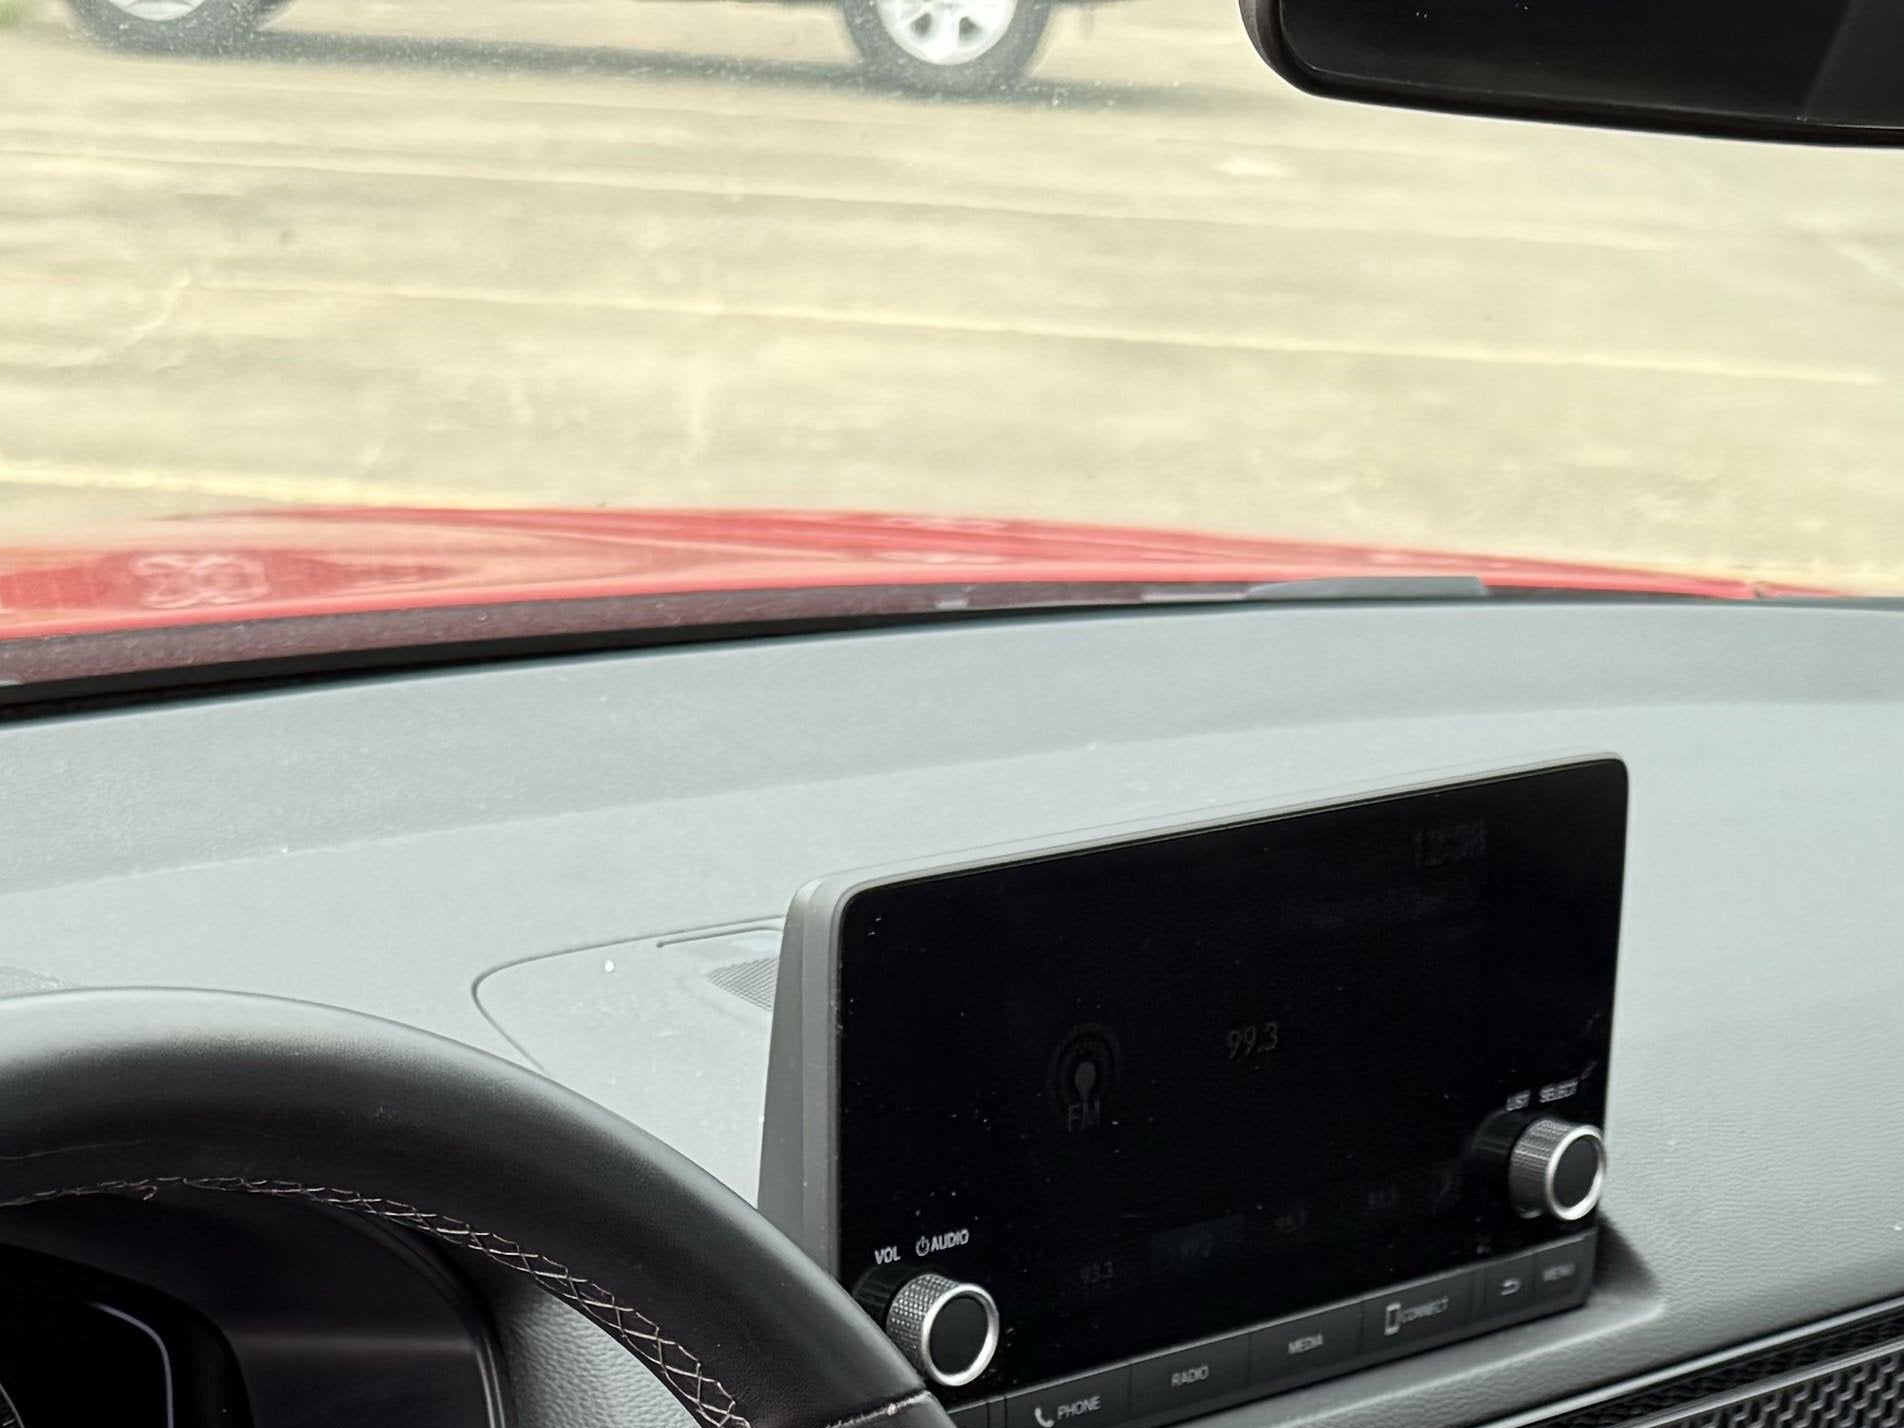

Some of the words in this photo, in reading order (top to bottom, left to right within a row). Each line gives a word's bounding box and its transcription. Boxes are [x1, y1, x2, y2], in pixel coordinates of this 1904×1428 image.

[930, 1229, 970, 1253] AUDIO
[873, 1246, 901, 1265] VOL
[1170, 1365, 1210, 1388] RADIO
[1056, 1396, 1102, 1421] PHONE
